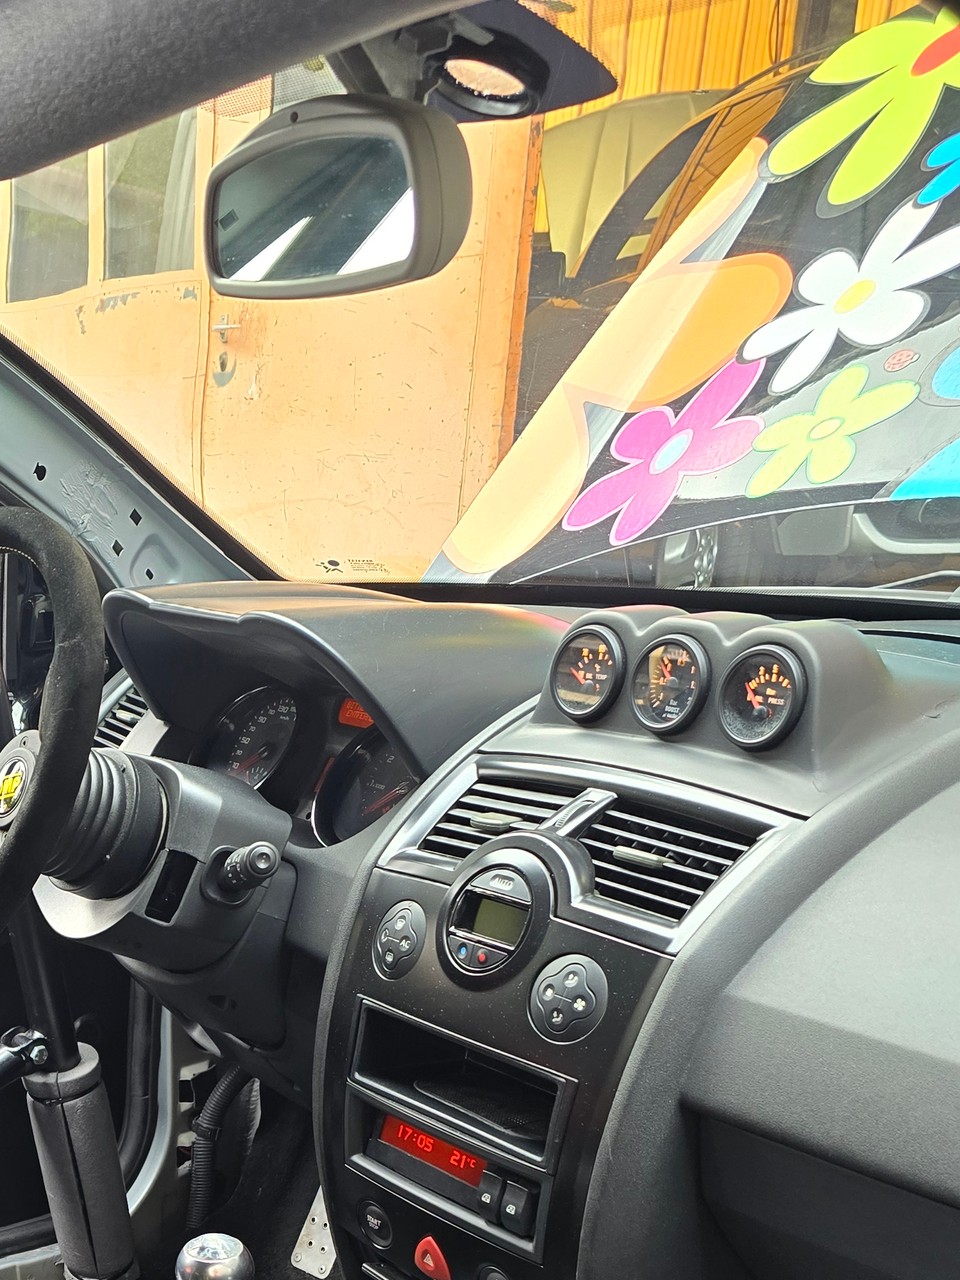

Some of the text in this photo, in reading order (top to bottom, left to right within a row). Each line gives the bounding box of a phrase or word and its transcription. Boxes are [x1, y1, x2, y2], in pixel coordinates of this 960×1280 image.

[240, 736, 251, 744] 50
[494, 876, 513, 888] AUTO
[399, 939, 411, 949] AC
[397, 1124, 434, 1152] 17:05
[367, 1214, 382, 1226] START
